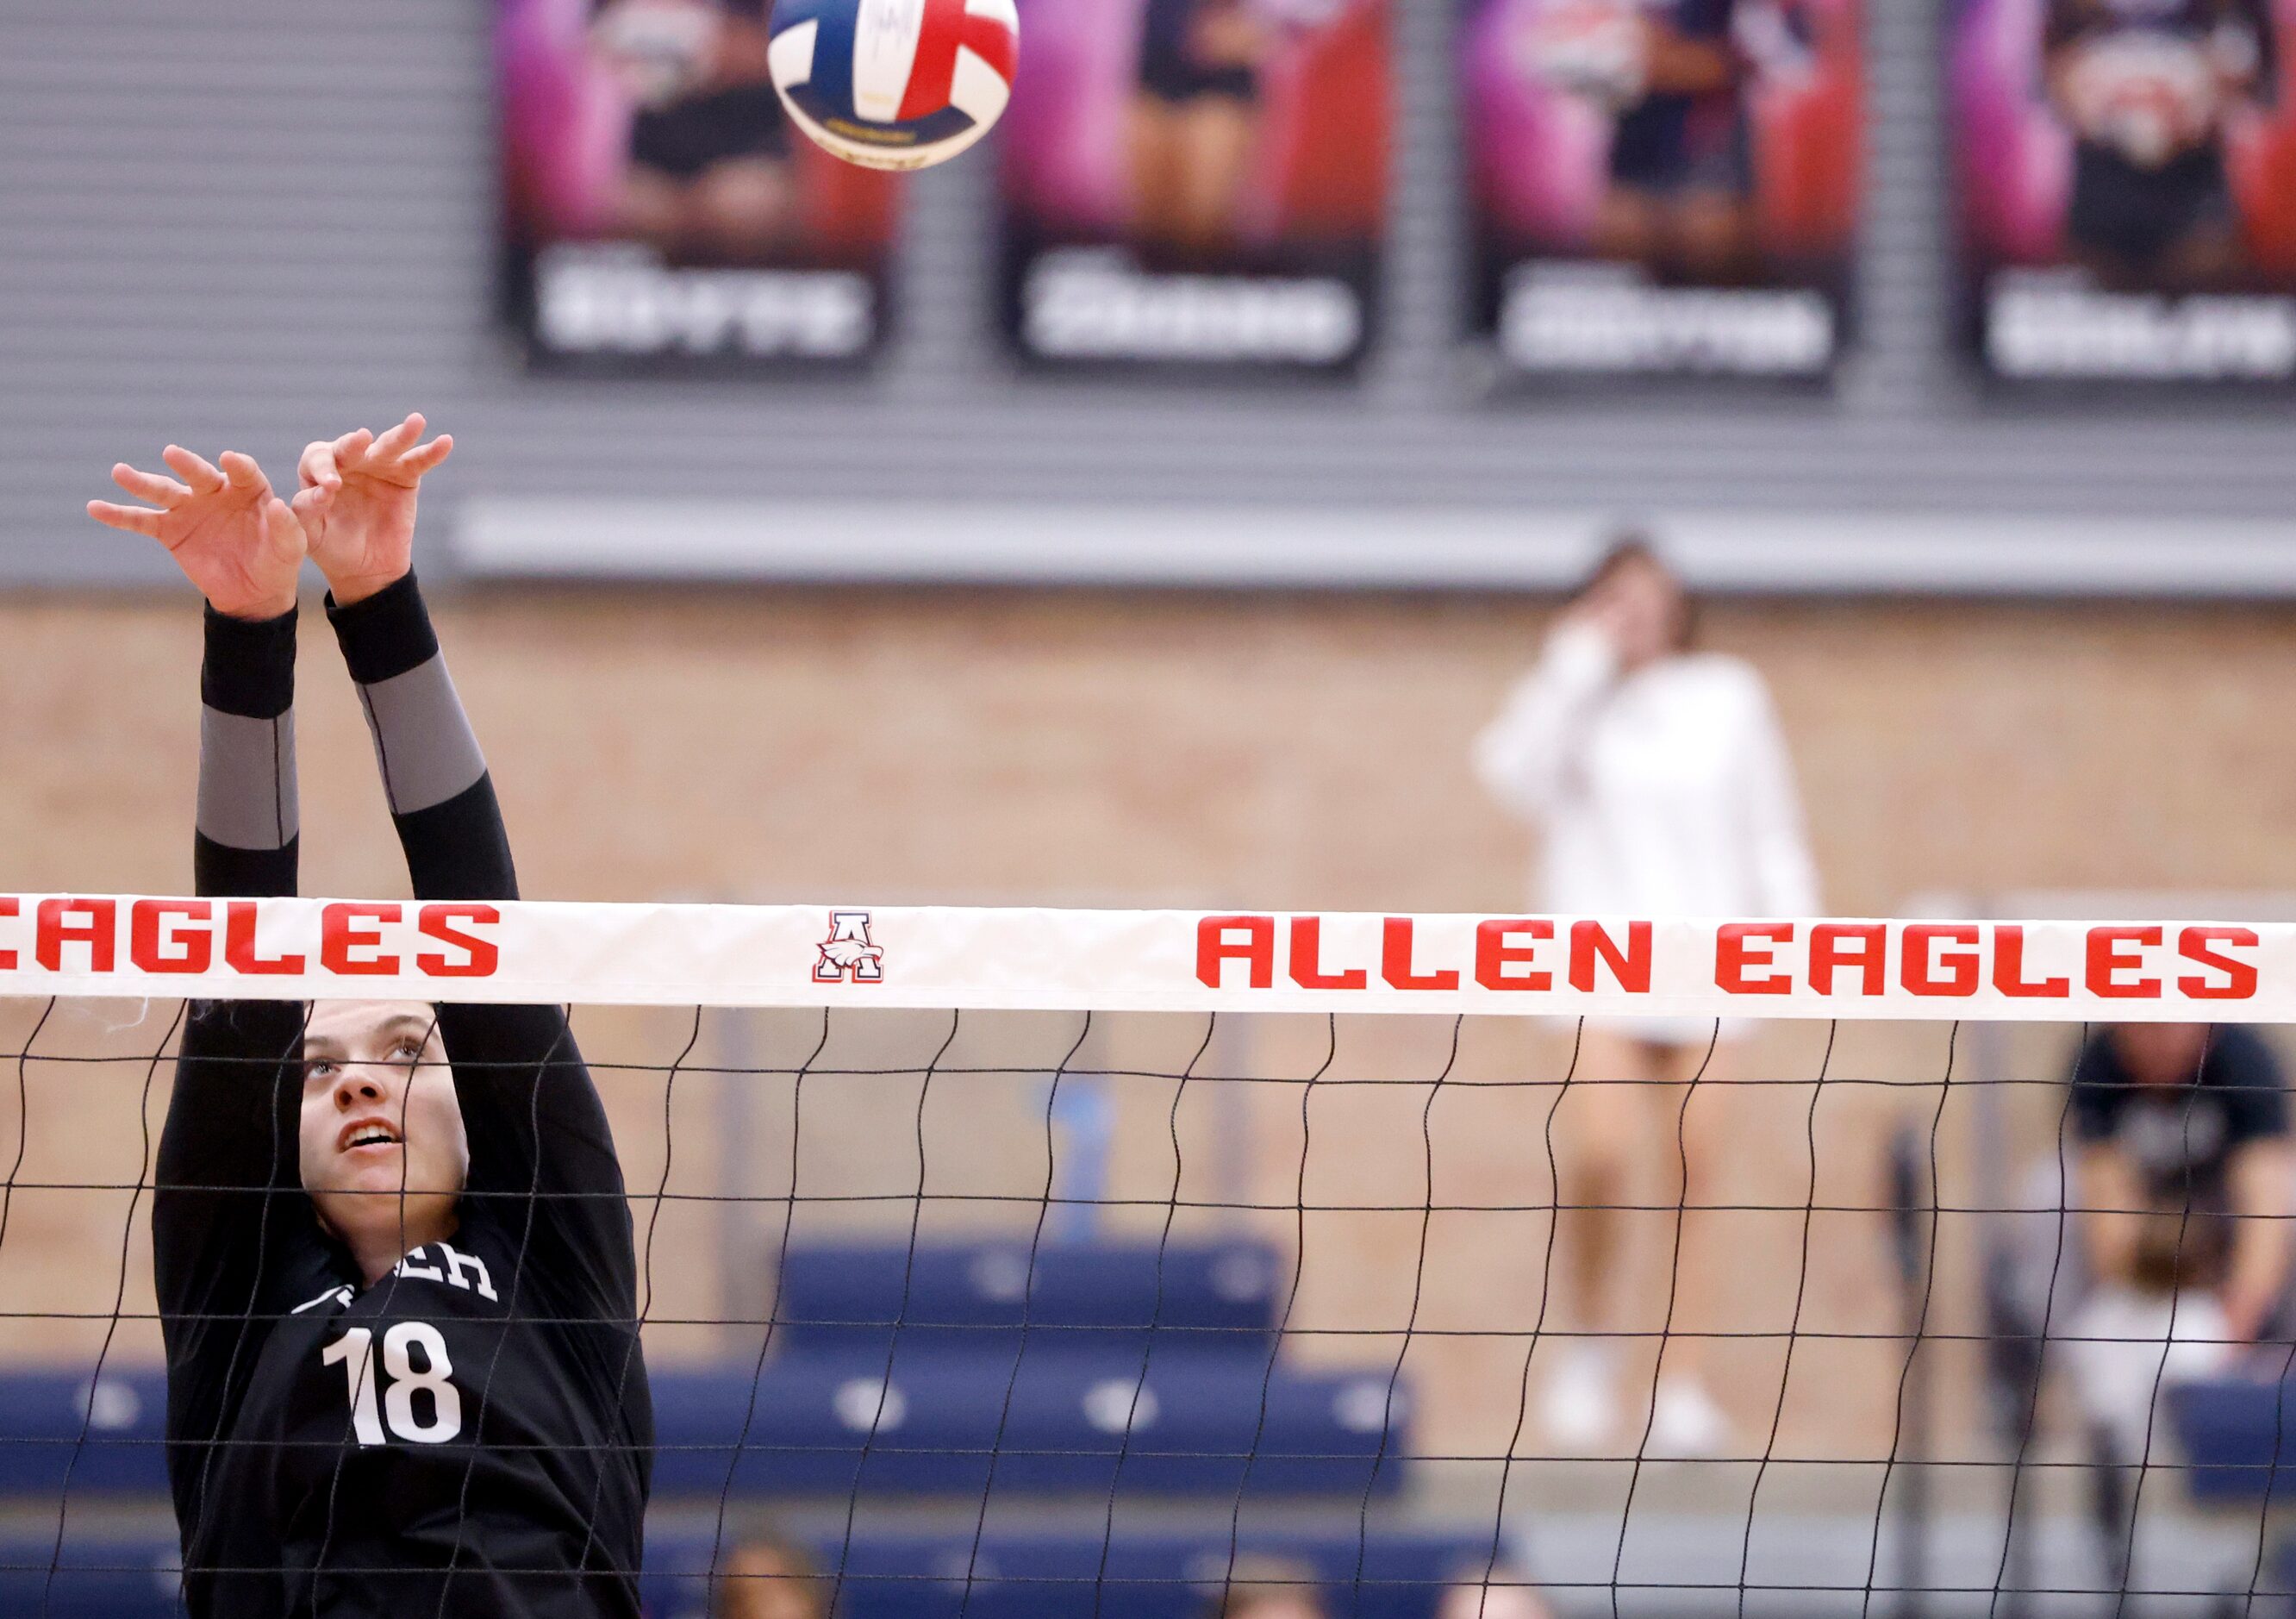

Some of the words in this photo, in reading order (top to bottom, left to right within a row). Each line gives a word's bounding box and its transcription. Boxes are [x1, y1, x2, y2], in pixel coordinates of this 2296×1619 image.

[0, 897, 500, 977] AGLES
[1196, 916, 1652, 993] ALLEN
[1714, 922, 2259, 999] EAGLES
[322, 1321, 462, 1446] 18
